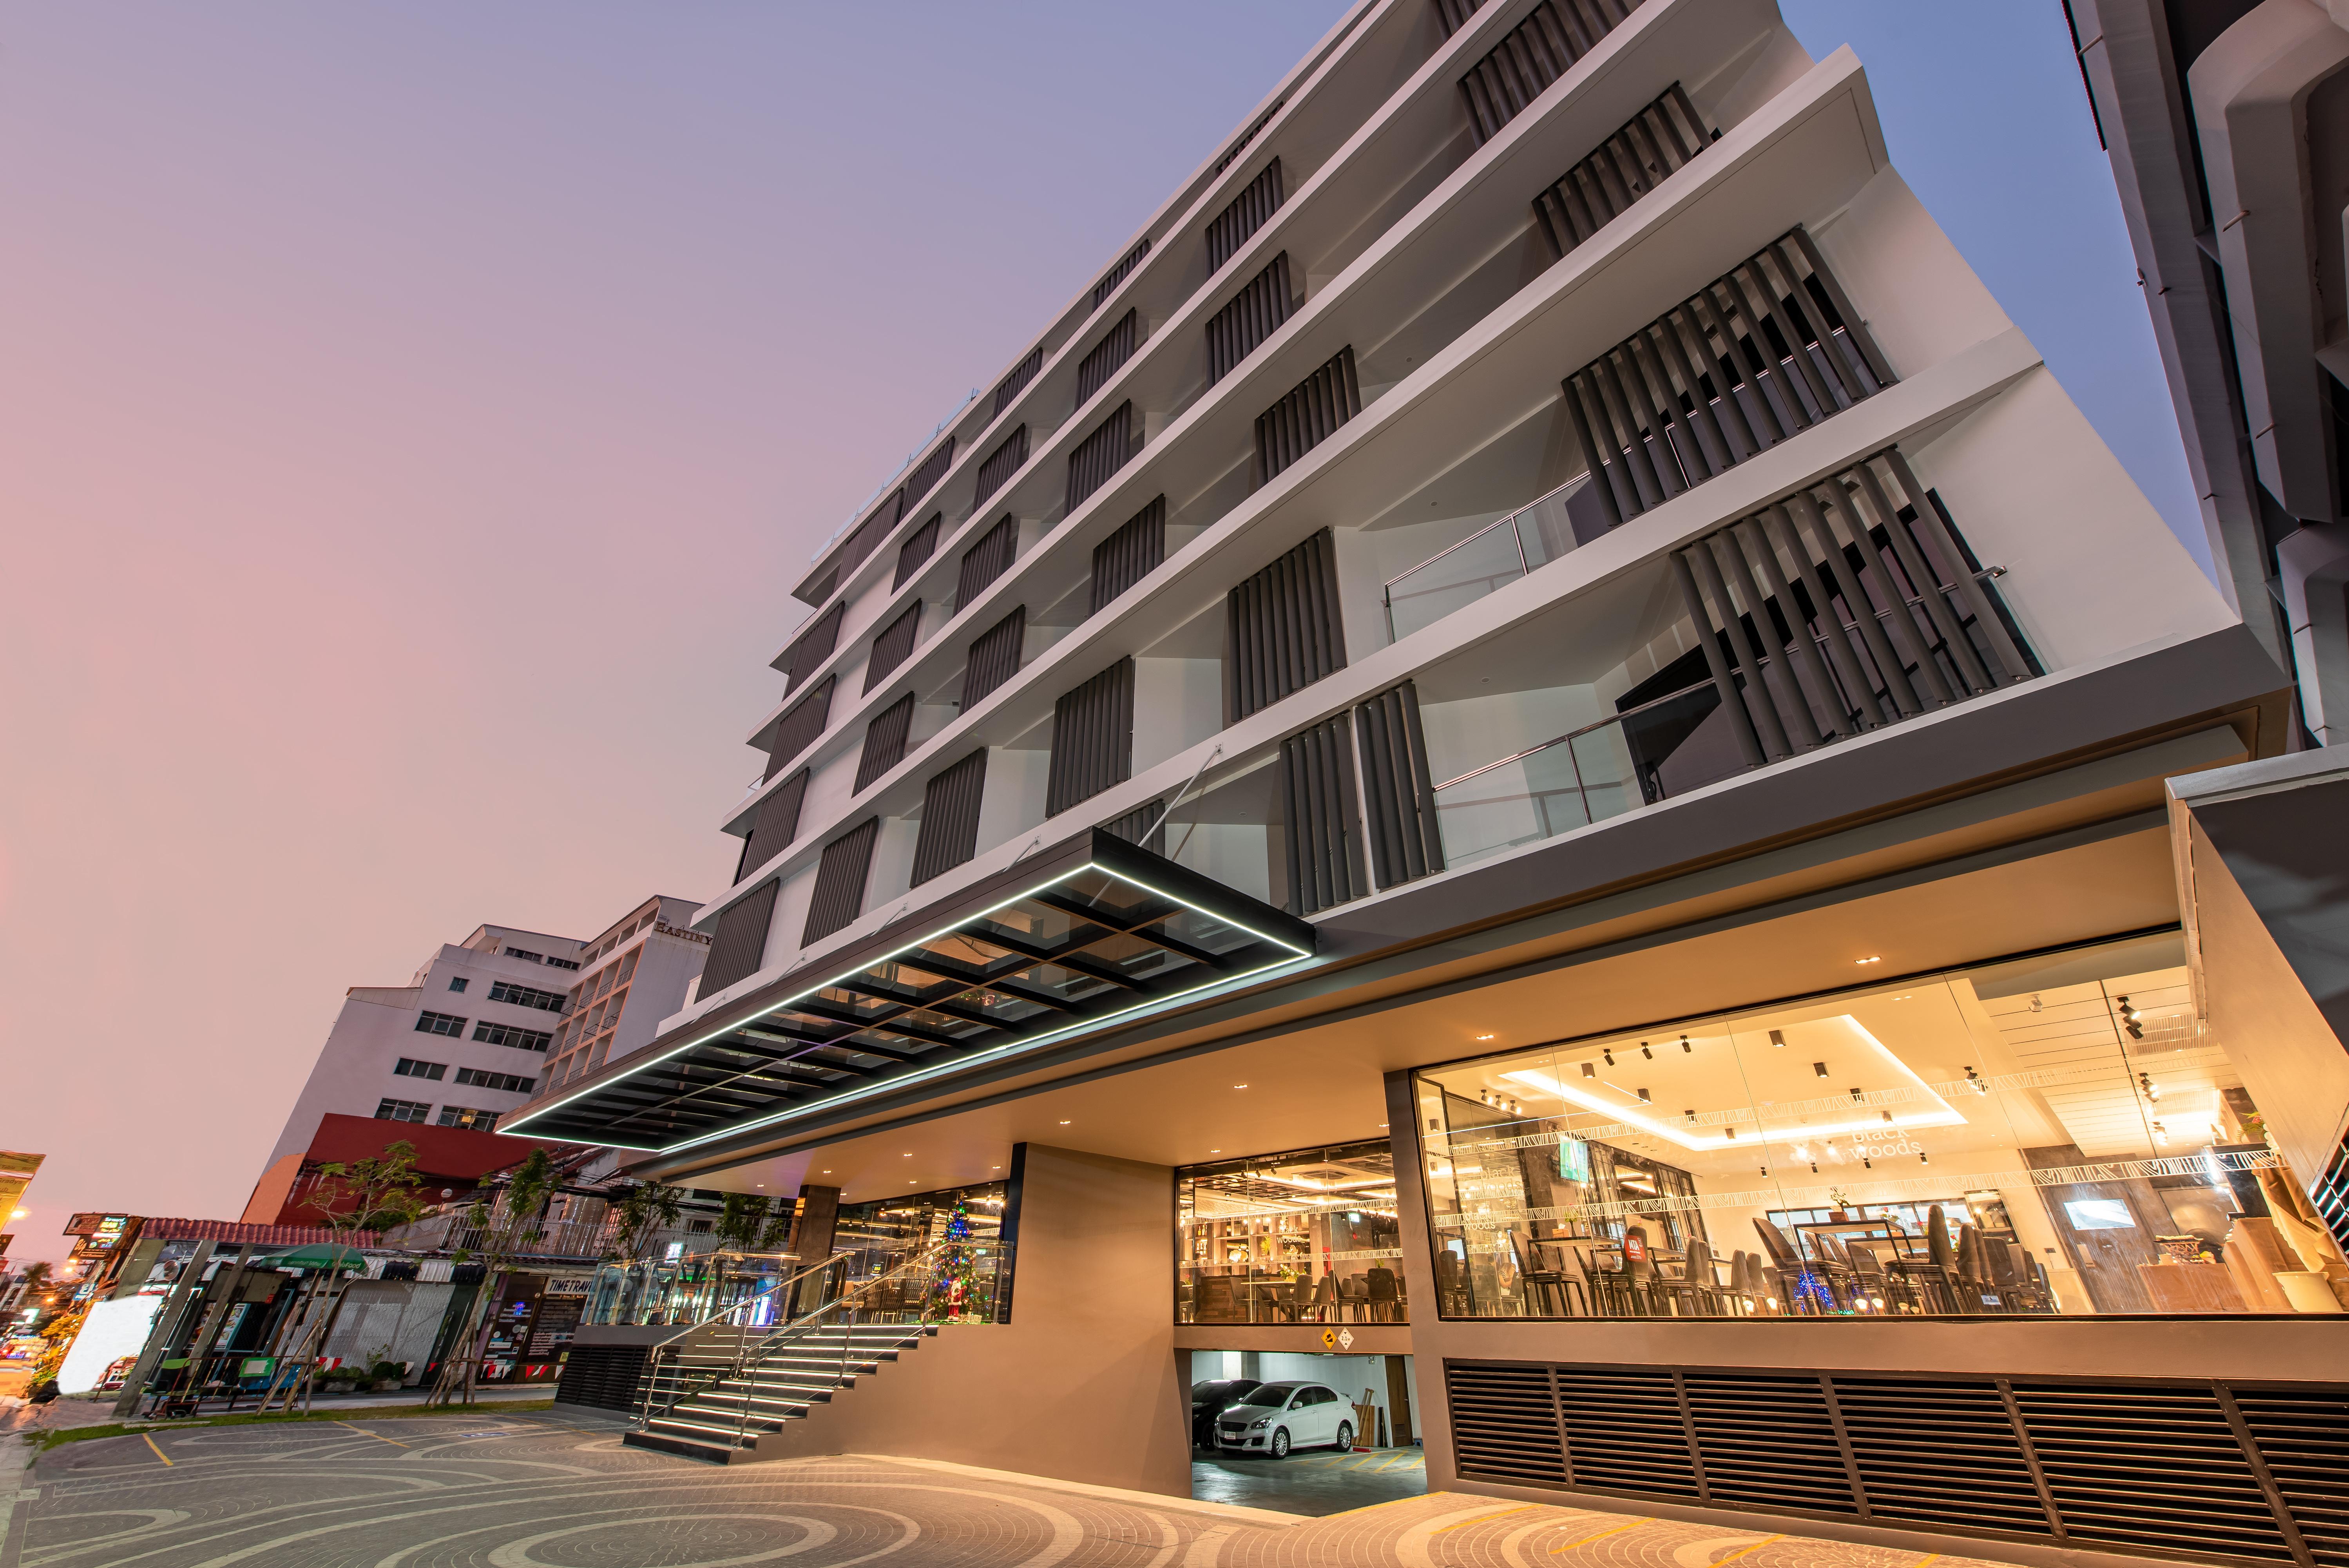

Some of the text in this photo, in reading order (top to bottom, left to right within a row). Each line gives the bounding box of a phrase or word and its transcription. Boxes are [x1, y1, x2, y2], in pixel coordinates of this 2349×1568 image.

[654, 921, 713, 945] EASTINY
[1850, 1124, 1910, 1143] black
[1849, 1139, 1922, 1159] woods
[1480, 1165, 1515, 1179] black
[1480, 1178, 1523, 1192] woods
[1463, 1221, 1496, 1230] woods
[549, 1279, 570, 1292] TIME
